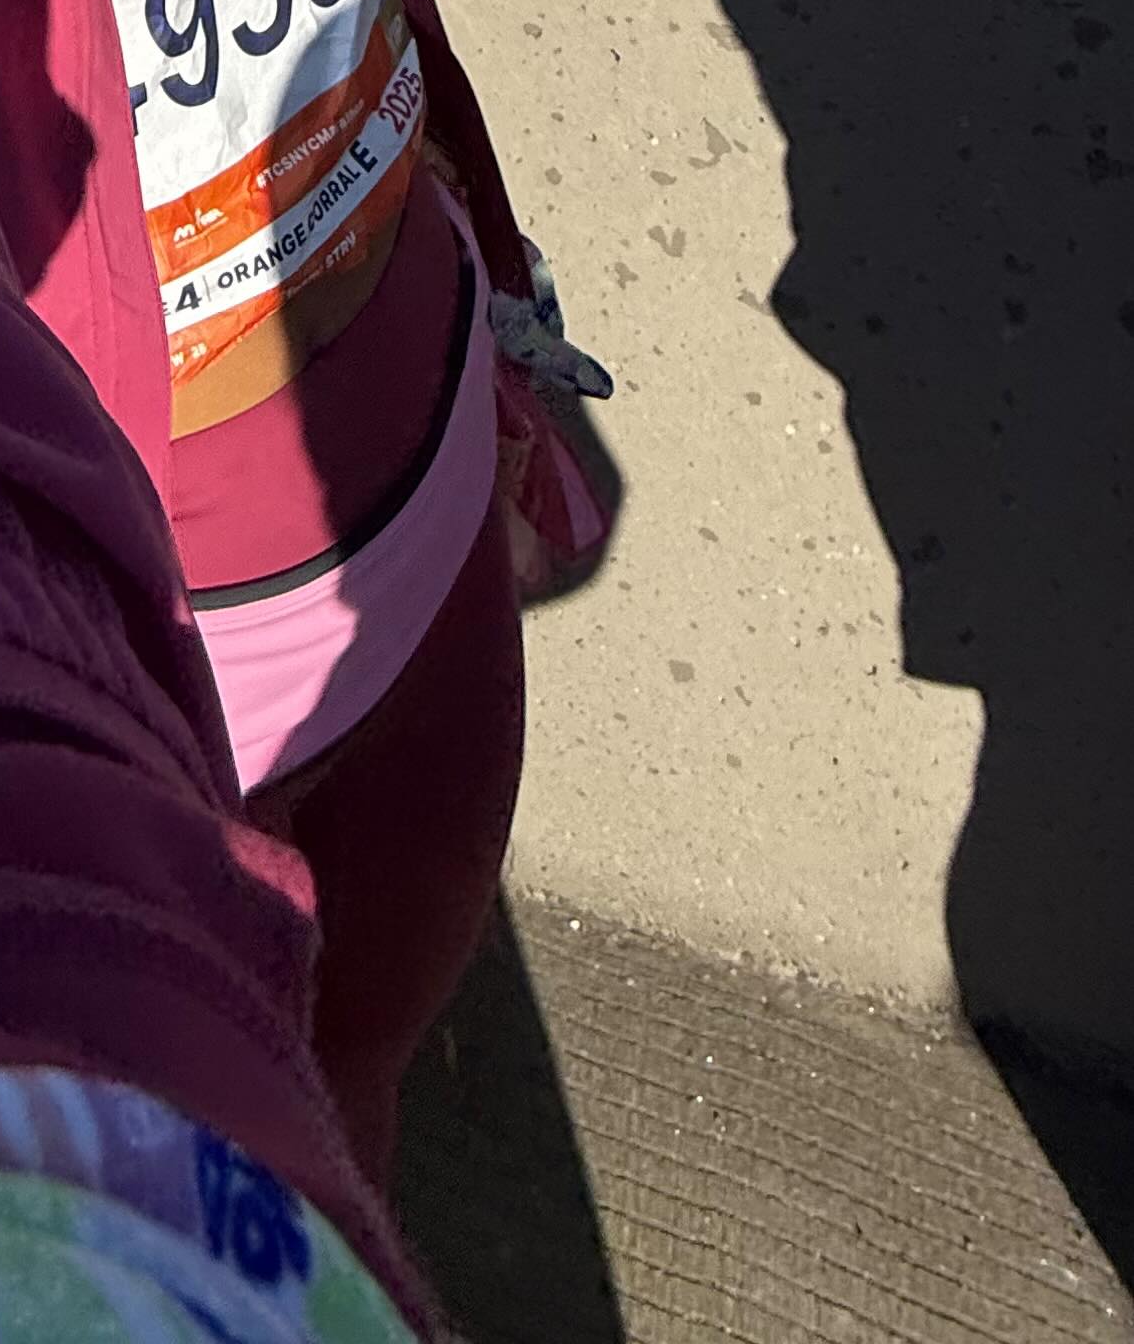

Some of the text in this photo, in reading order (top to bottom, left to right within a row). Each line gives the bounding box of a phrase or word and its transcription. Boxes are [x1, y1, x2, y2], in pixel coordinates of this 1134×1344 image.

[378, 66, 422, 135] 2025
[175, 281, 203, 312] 4
[217, 223, 307, 289] ORANGE
[307, 169, 361, 233] CORRAL
[350, 140, 378, 173] E
